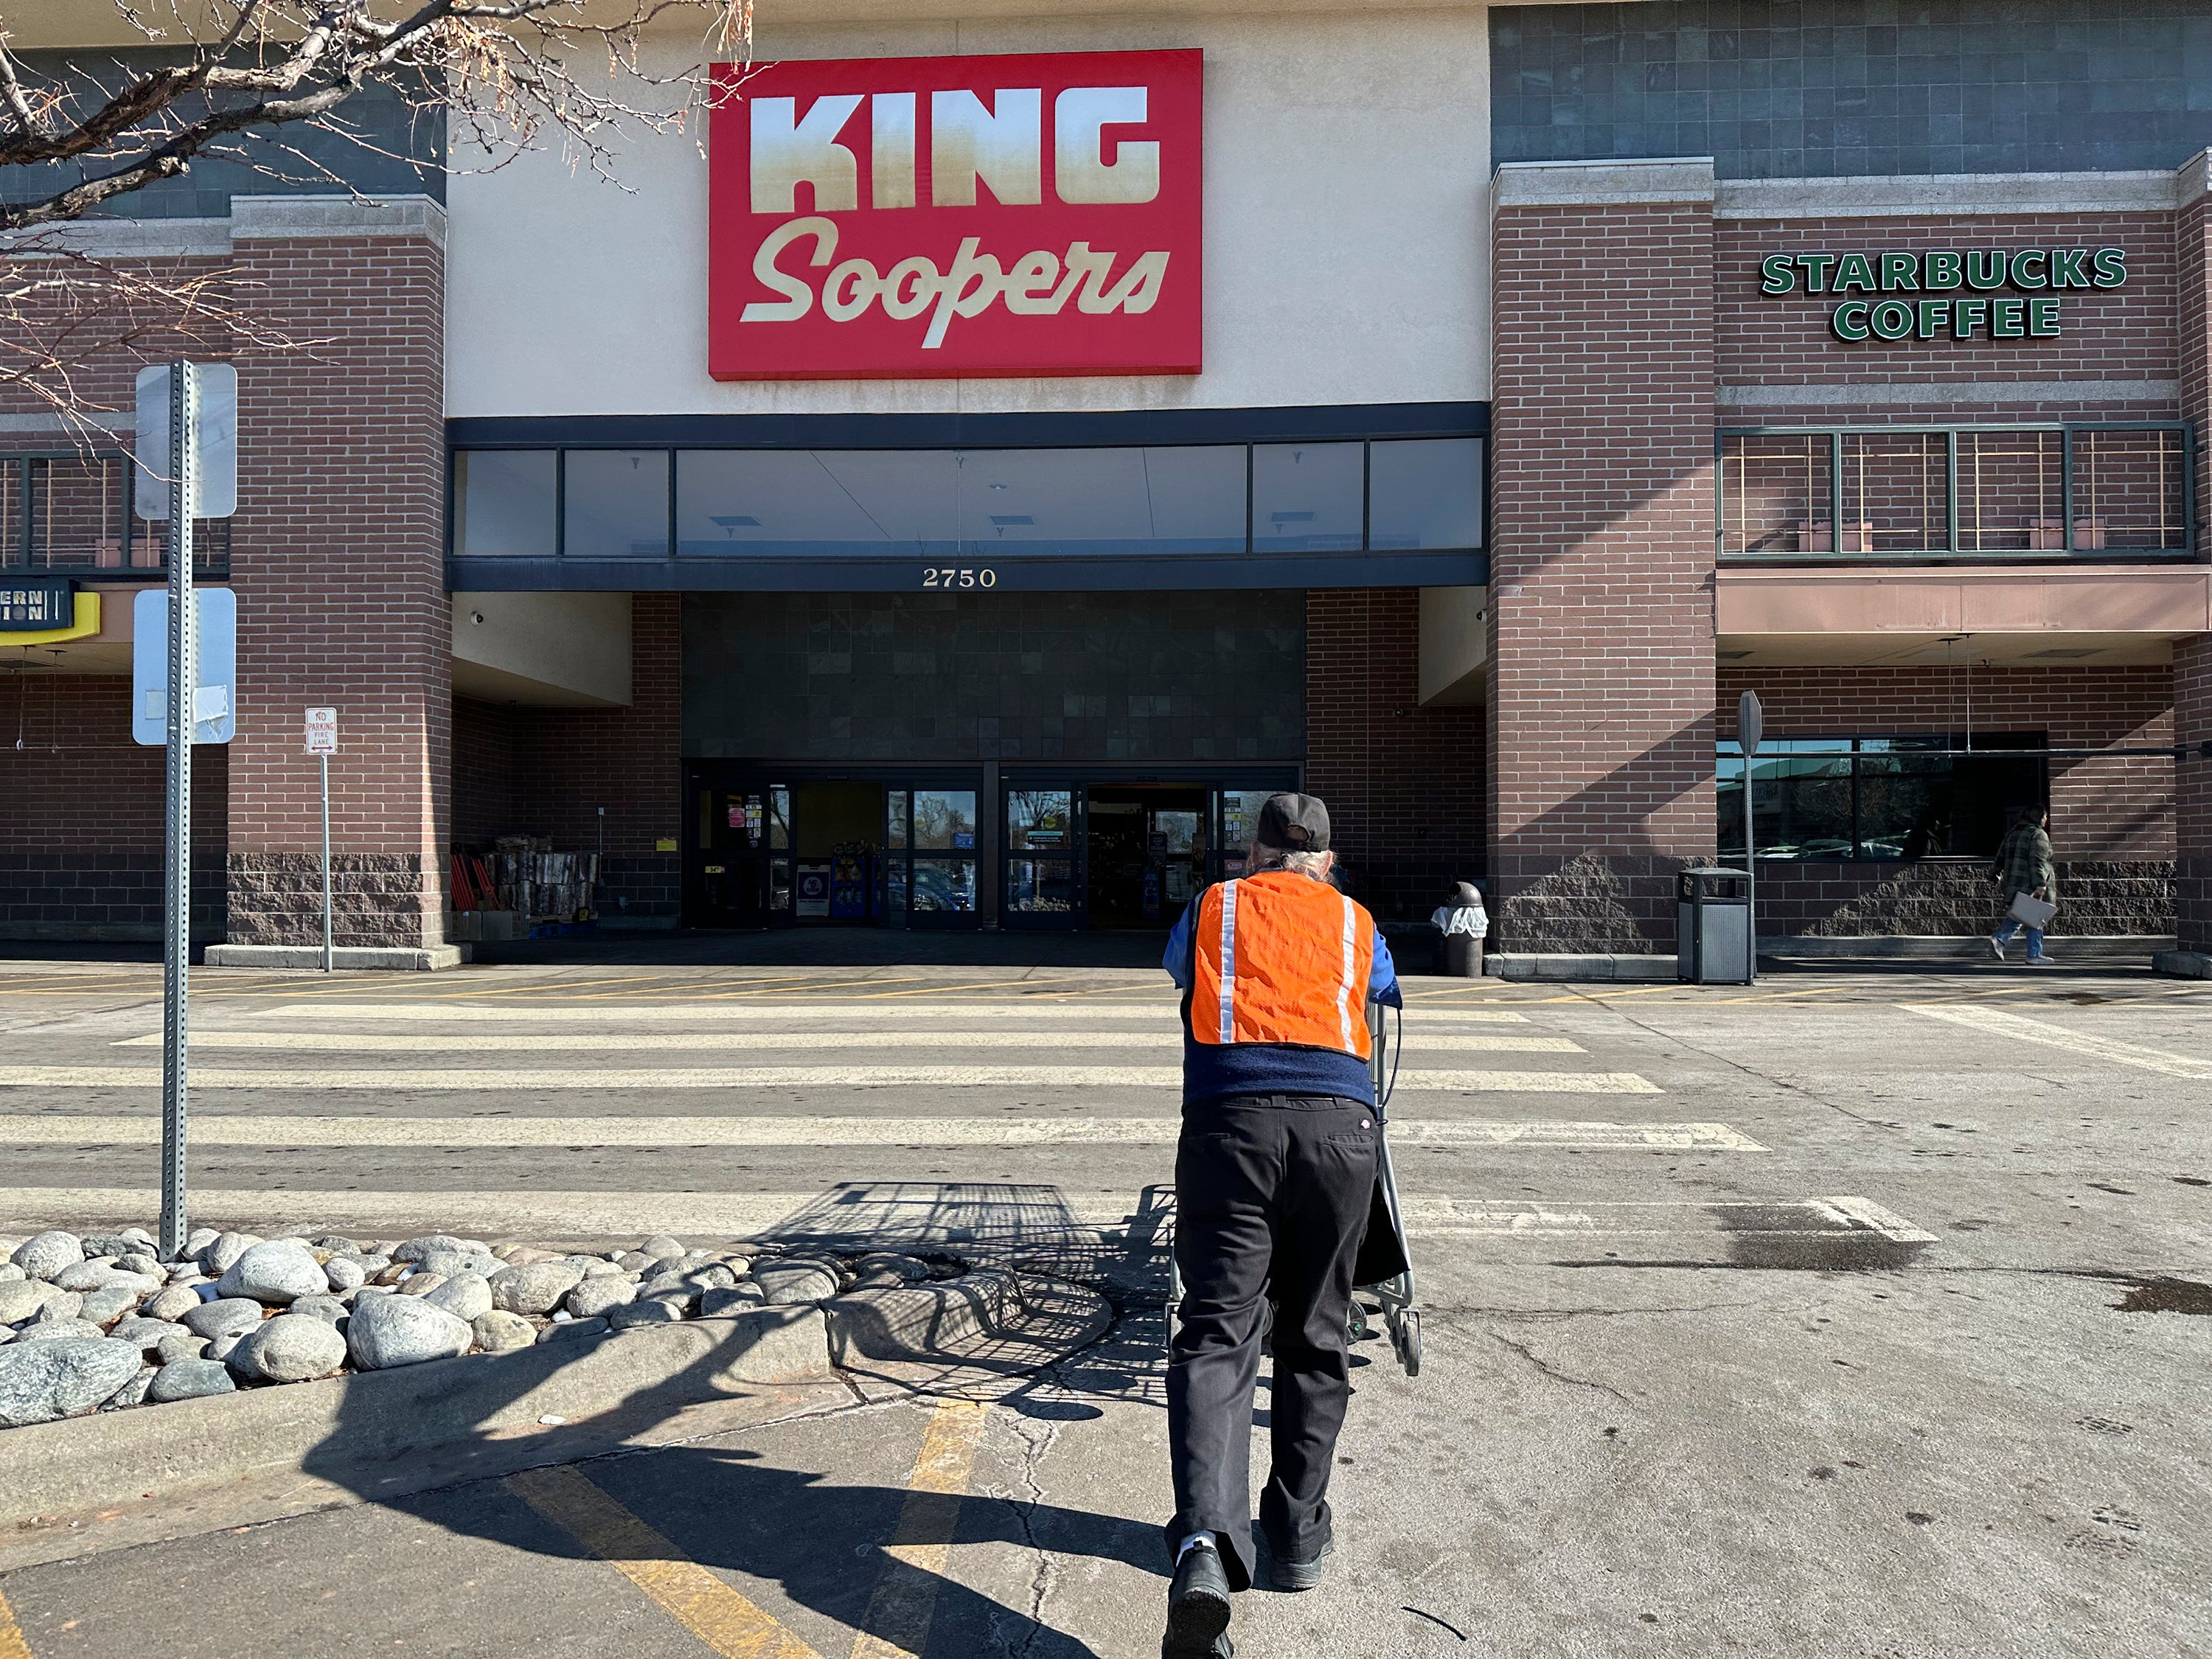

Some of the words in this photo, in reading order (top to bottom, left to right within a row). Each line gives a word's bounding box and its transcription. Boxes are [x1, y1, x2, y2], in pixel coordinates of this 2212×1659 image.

[749, 86, 1161, 213] KING
[739, 216, 1171, 349] Soopers
[1761, 248, 2127, 294] STARBUCKS
[1833, 297, 2062, 340] COFFEE
[922, 568, 996, 588] 2750
[308, 723, 334, 731] PARKING
[316, 712, 327, 721] NO
